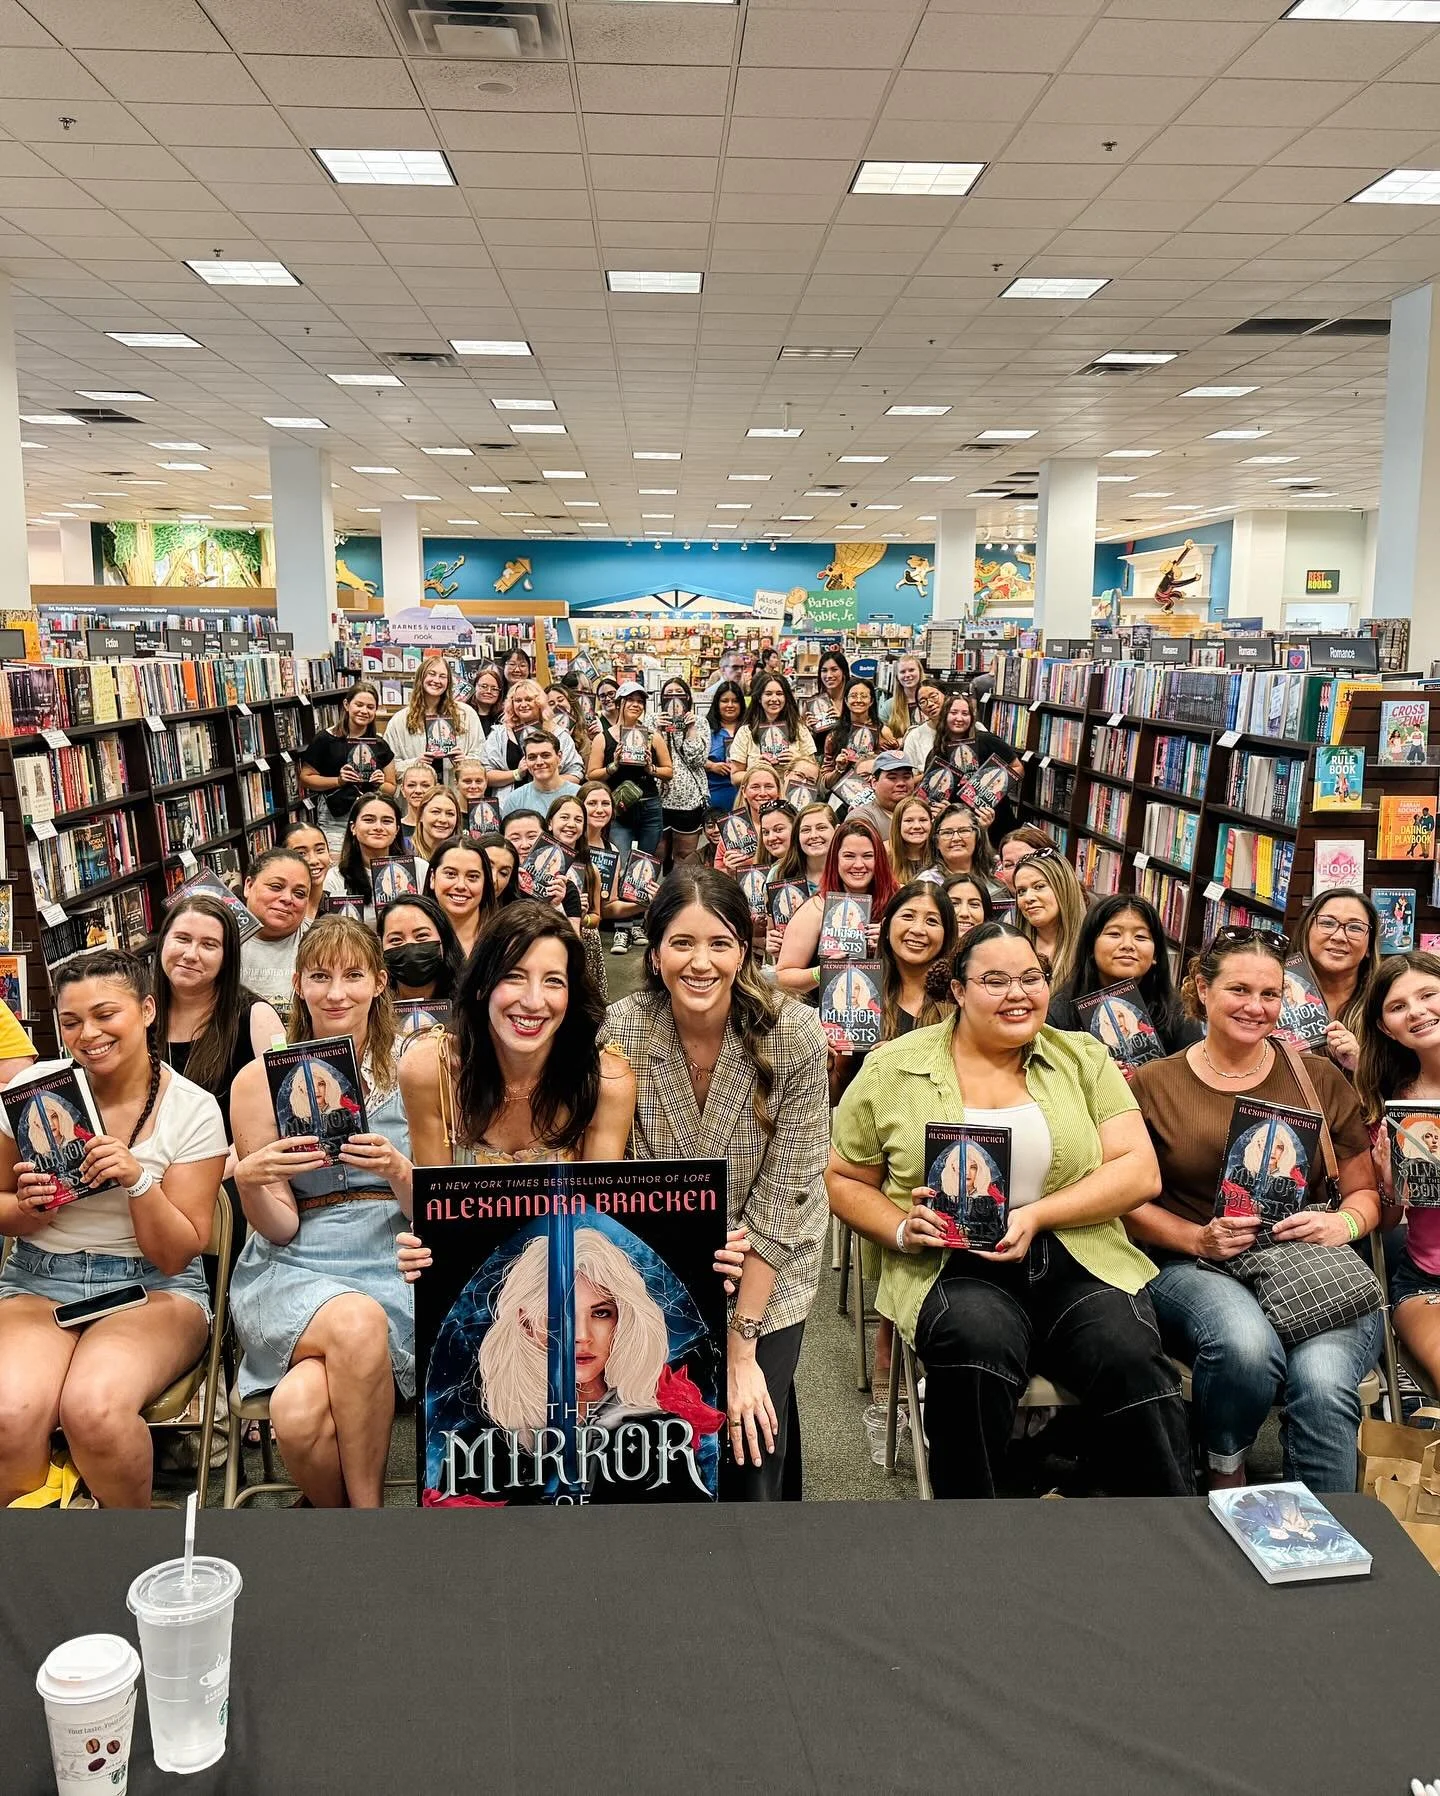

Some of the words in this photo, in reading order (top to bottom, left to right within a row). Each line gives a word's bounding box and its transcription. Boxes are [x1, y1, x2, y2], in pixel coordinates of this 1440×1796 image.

[1308, 571, 1327, 581] REST
[1308, 580, 1333, 590] ROOMS
[808, 596, 845, 608] Barnes
[845, 597, 855, 608] &
[807, 610, 841, 622] Noble,
[841, 609, 855, 621] Jr.
[105, 637, 119, 648] Fiction
[1238, 647, 1258, 657] Romance
[1329, 646, 1356, 660] Romance
[1391, 703, 1425, 718] CROSS
[1331, 755, 1356, 765] RULE
[1329, 764, 1356, 775] BOOK
[1401, 825, 1427, 835] DATING
[1395, 834, 1432, 844] PLAYBOOK
[1320, 863, 1361, 875] HOOK
[823, 927, 866, 941] MIRROR
[823, 941, 863, 953] BEASTS
[824, 1009, 880, 1026] MIRROR
[1276, 1002, 1327, 1030] IRROR
[827, 1028, 878, 1043] BEASTS
[429, 1182, 442, 1191] #1
[446, 1181, 471, 1191] NEW
[474, 1179, 503, 1190] YORK
[506, 1178, 539, 1188] TIMES
[543, 1176, 614, 1187] BESTSELLING
[617, 1175, 661, 1184] AUTHOR
[664, 1174, 680, 1184] OF
[683, 1173, 711, 1183] LORE
[426, 1192, 586, 1221] ALEXANDRA
[596, 1189, 718, 1215] BRACKEN
[549, 1402, 600, 1420] THE
[432, 1419, 714, 1502] MIRROR
